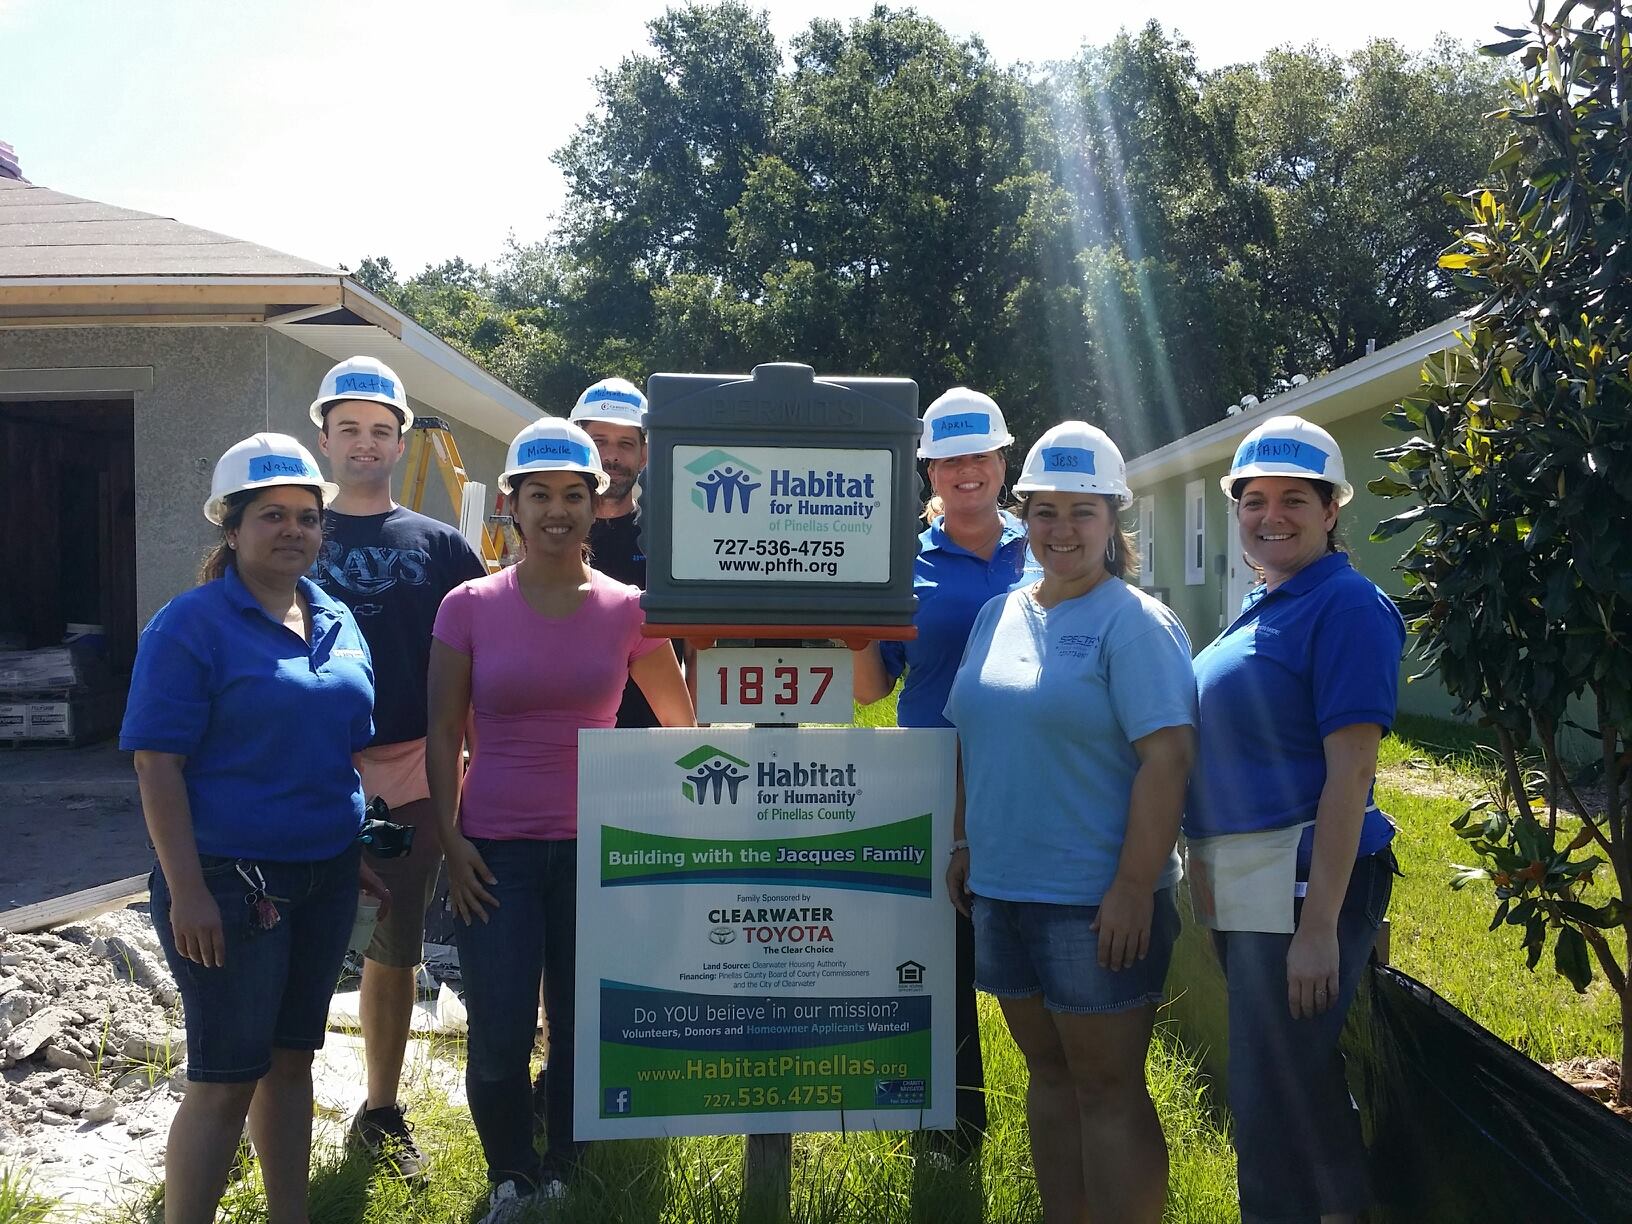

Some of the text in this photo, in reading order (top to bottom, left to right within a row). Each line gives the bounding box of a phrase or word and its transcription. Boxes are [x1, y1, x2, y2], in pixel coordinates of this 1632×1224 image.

[941, 420, 974, 430] APRIL
[527, 445, 572, 457] Michelle
[1051, 453, 1079, 467] JESS
[770, 469, 874, 498] Habitat
[769, 500, 793, 515] for
[769, 519, 873, 535] of Pinellas County
[713, 539, 845, 557] 727-536-4755
[718, 558, 838, 576] www.phfh.org
[717, 666, 834, 705] 1837
[757, 762, 856, 787] Habitat
[757, 790, 779, 804] for
[757, 808, 856, 822] of Pinellas County
[608, 846, 925, 867] Building with the Jacques Family
[737, 893, 811, 903] Family Sponsored by
[708, 907, 834, 923] CLEARWATER
[743, 926, 834, 943] TOYOTA
[763, 945, 834, 954] The Clear Choice
[722, 962, 750, 970] Source:
[752, 961, 787, 969] Clearwater
[788, 960, 815, 969] Housing
[817, 960, 847, 968] Authority
[680, 972, 717, 981] Financing:
[718, 971, 742, 979] Pinellas
[743, 971, 767, 979] County
[768, 970, 788, 978] Board
[796, 969, 820, 979] County
[821, 969, 870, 977] Commissioners
[759, 980, 772, 989] City
[773, 979, 781, 988] of
[781, 979, 816, 988] Clearwater
[634, 1008, 657, 1024] Do
[663, 1005, 700, 1022] YOU
[772, 1003, 787, 1019] in
[793, 1005, 823, 1019] our
[828, 1001, 900, 1018] mission?
[621, 1022, 911, 1039] Volunteers, Donors and Homeowner Applicants Wanted!
[637, 1054, 908, 1082] www.HabitatPinellas.org
[703, 1085, 843, 1108] 727.536.4755
